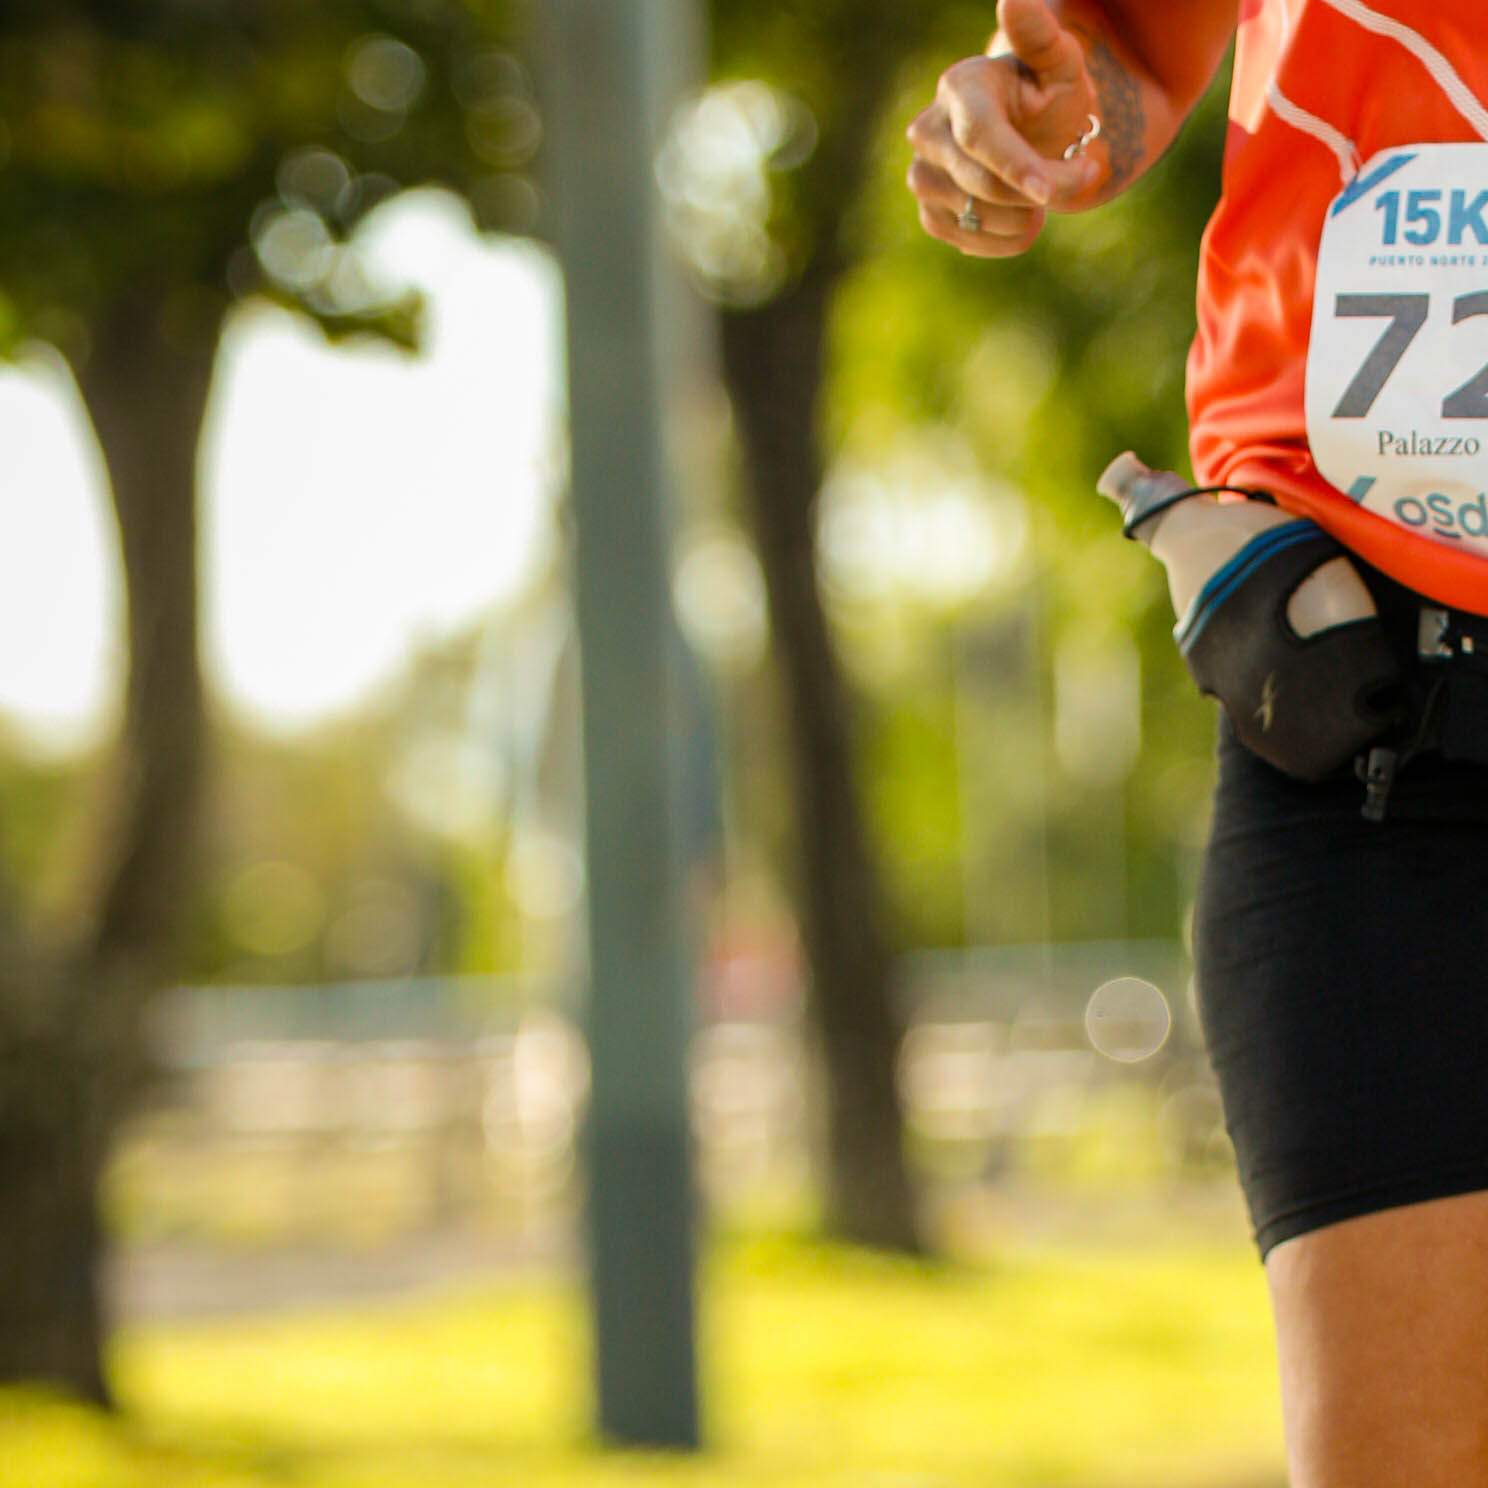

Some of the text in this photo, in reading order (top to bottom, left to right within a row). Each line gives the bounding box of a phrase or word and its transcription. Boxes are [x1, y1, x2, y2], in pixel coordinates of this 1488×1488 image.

[1369, 255, 1425, 267] PUERTO
[1430, 255, 1476, 267] NORTE
[1376, 429, 1480, 456] Palazzo
